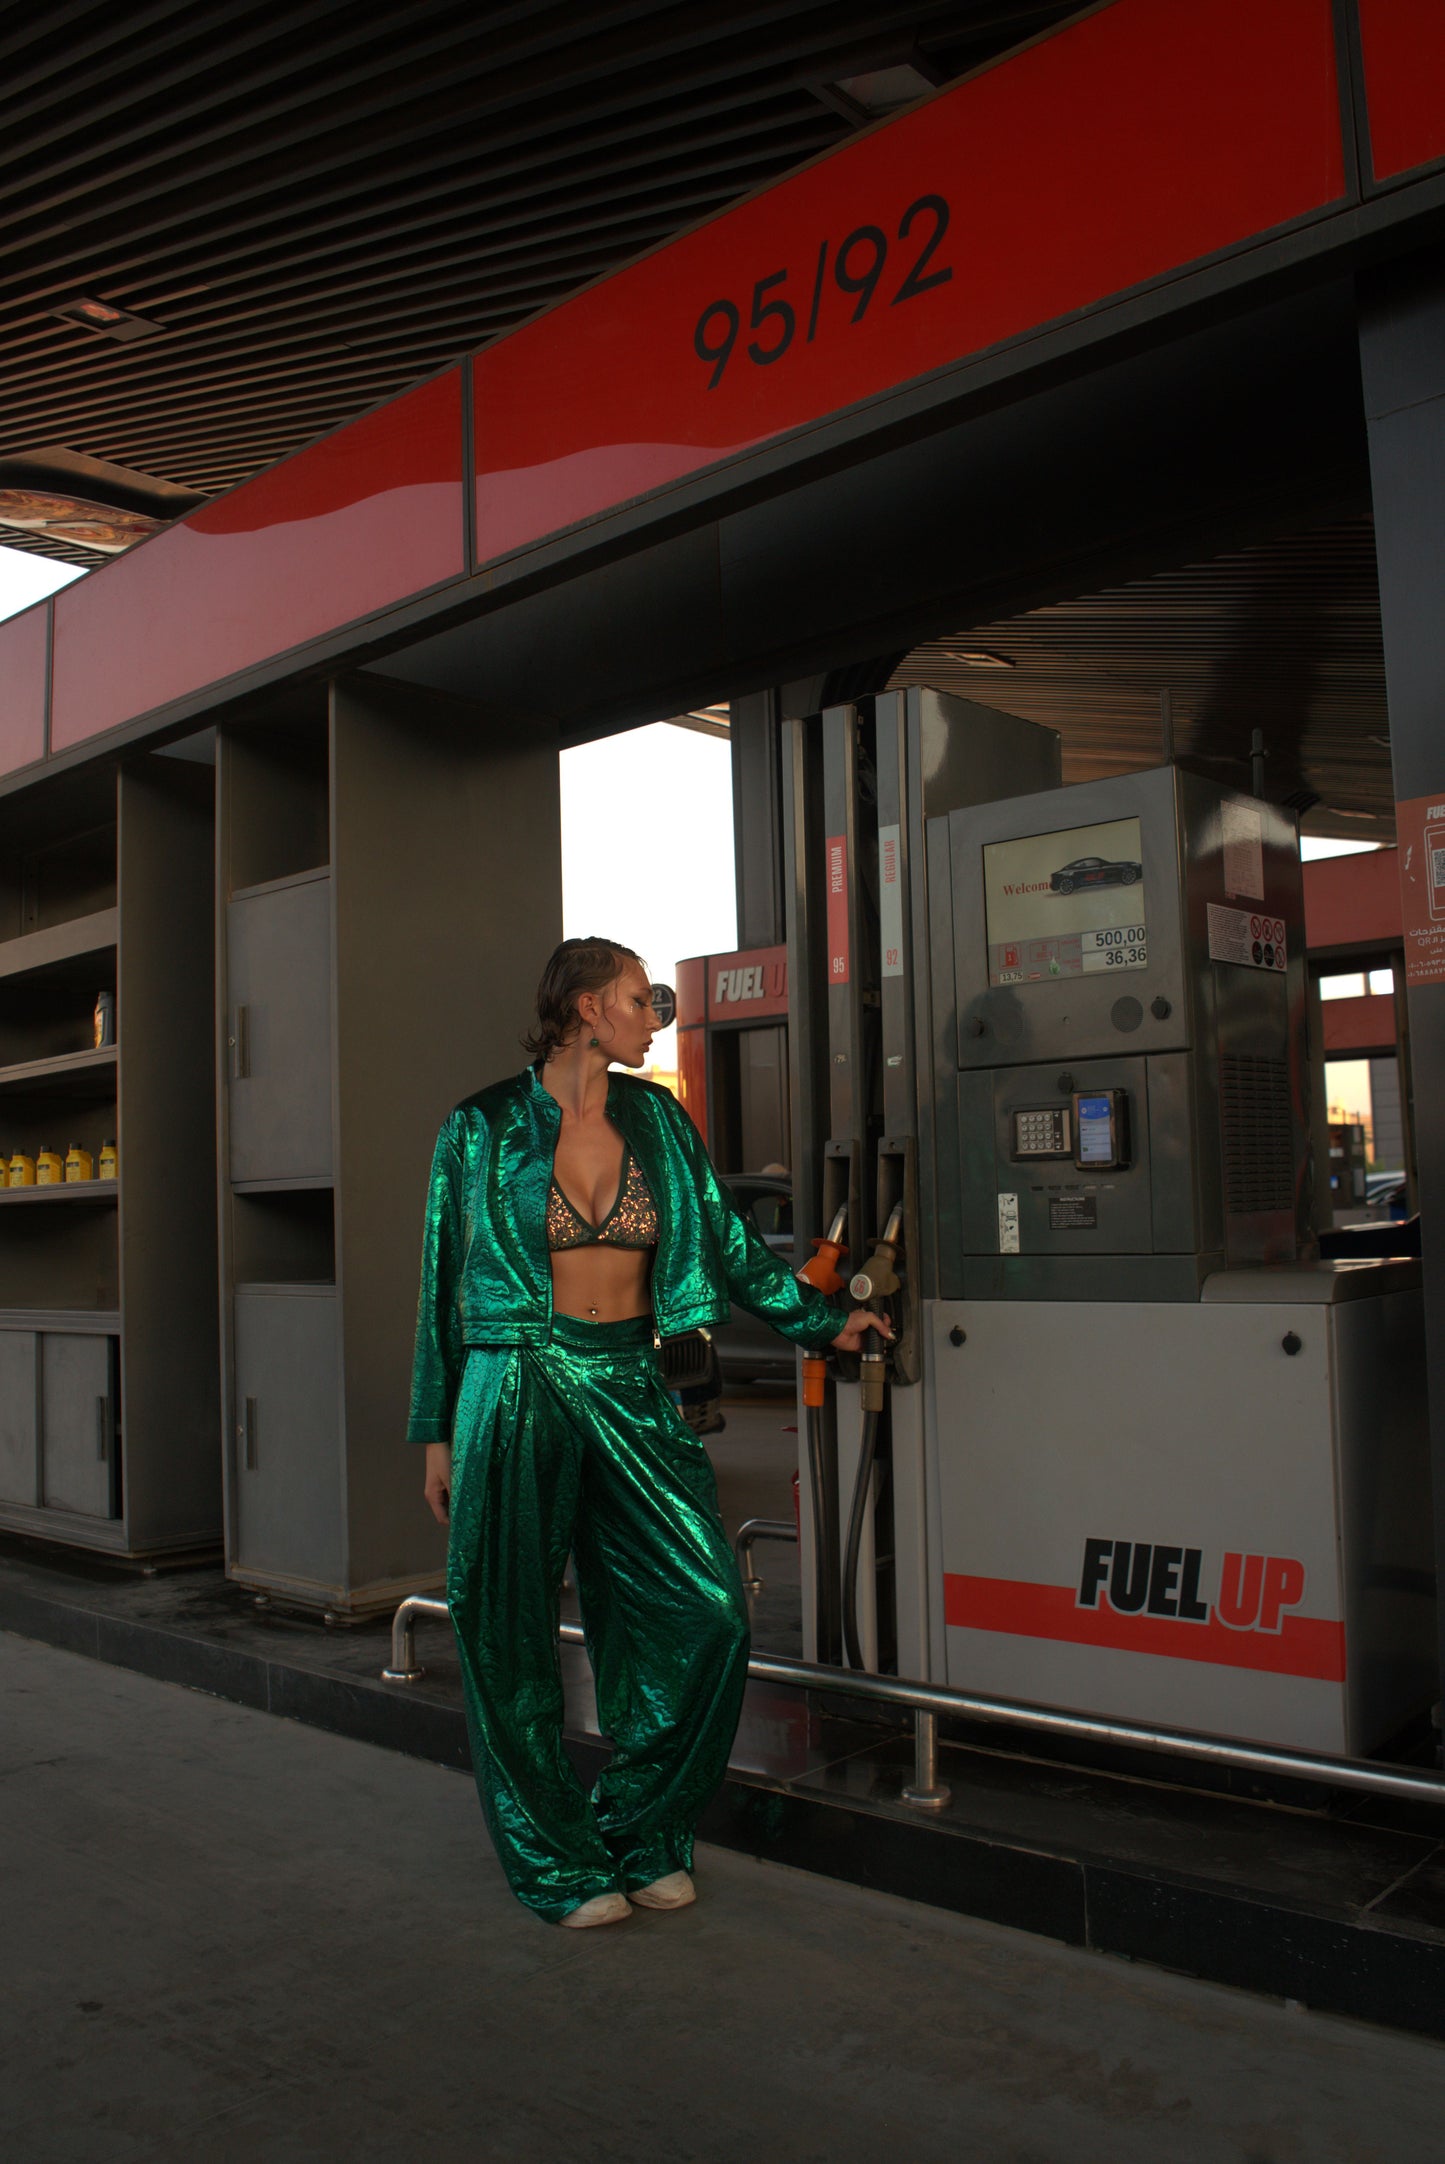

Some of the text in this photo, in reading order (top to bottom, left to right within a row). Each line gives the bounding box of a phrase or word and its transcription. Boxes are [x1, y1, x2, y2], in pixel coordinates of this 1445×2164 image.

[694, 194, 953, 391] 95/92
[831, 846, 843, 893] PREMUIM
[884, 840, 896, 883] REGULAR
[886, 949, 898, 966] 92
[1096, 927, 1146, 947] 500,00
[1105, 947, 1147, 966] 36,36
[715, 962, 788, 1003] FUEL U
[833, 957, 844, 974] 95
[1079, 1537, 1305, 1630] FUEL UP
